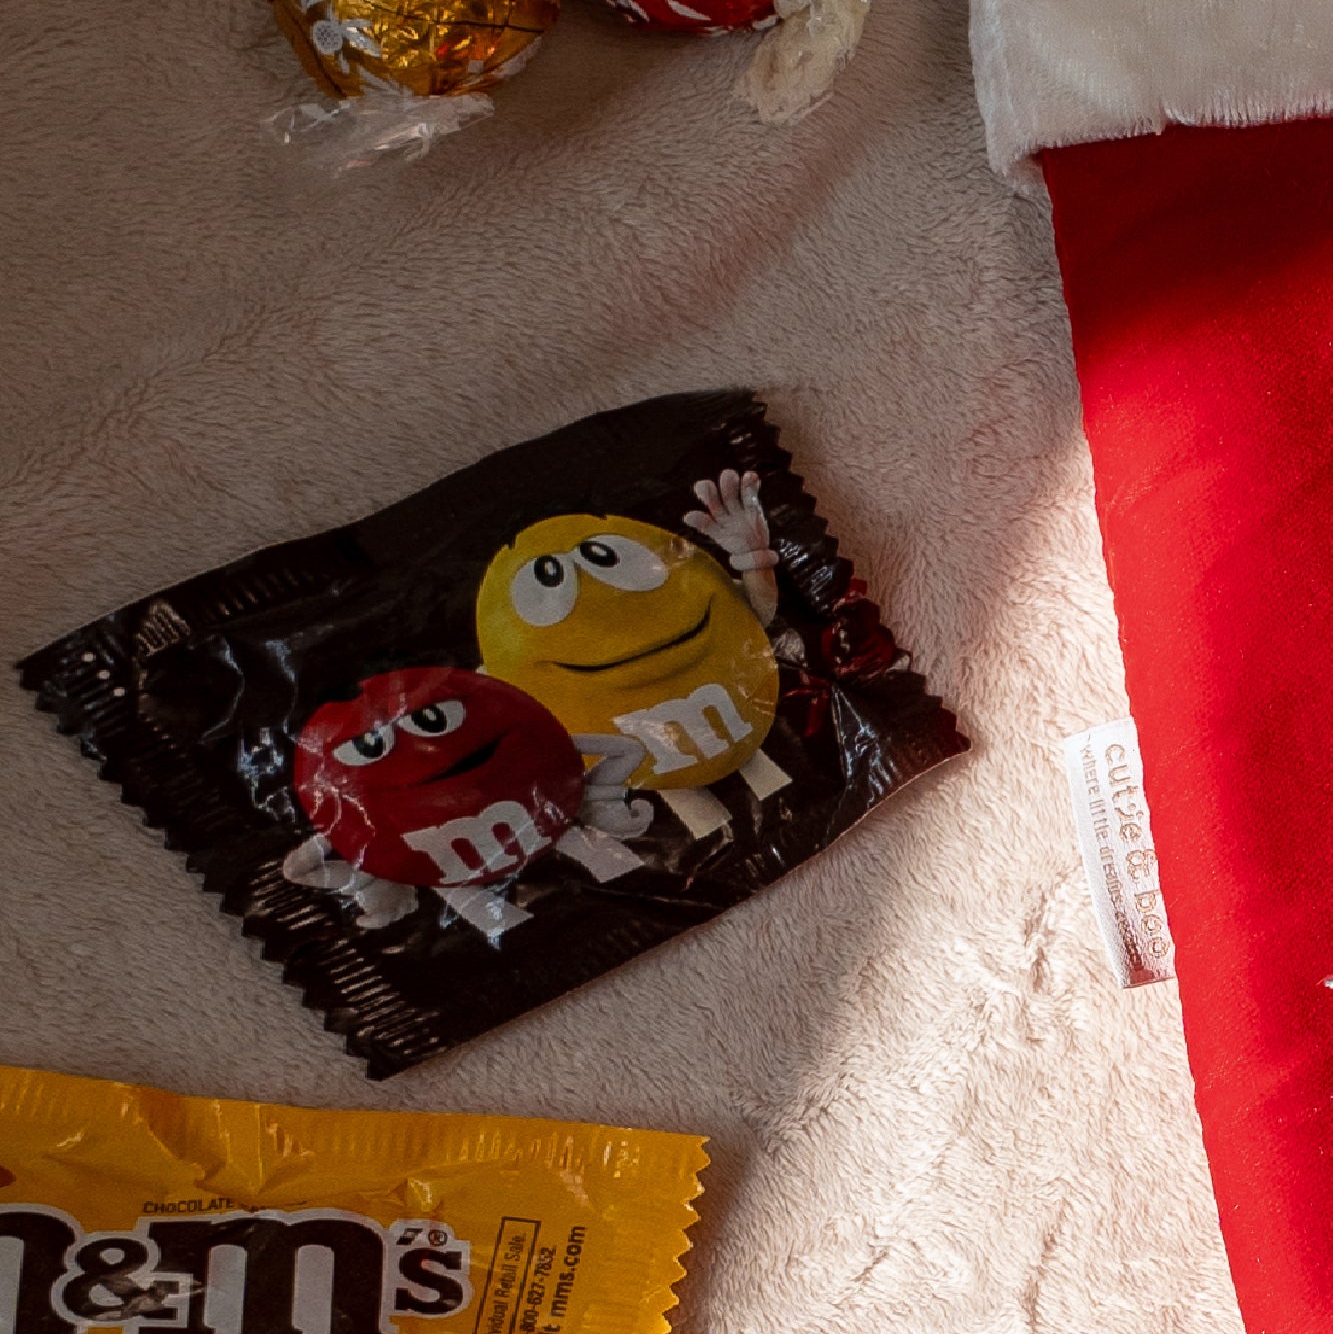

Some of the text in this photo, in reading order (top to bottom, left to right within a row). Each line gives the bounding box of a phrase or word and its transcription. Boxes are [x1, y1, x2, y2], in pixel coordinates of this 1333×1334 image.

[612, 683, 753, 774] m
[402, 800, 552, 884] m
[1104, 743, 1145, 844] cutie
[1133, 888, 1171, 959] boo
[494, 1265, 518, 1298] Retail
[551, 1225, 588, 1318] mms.com
